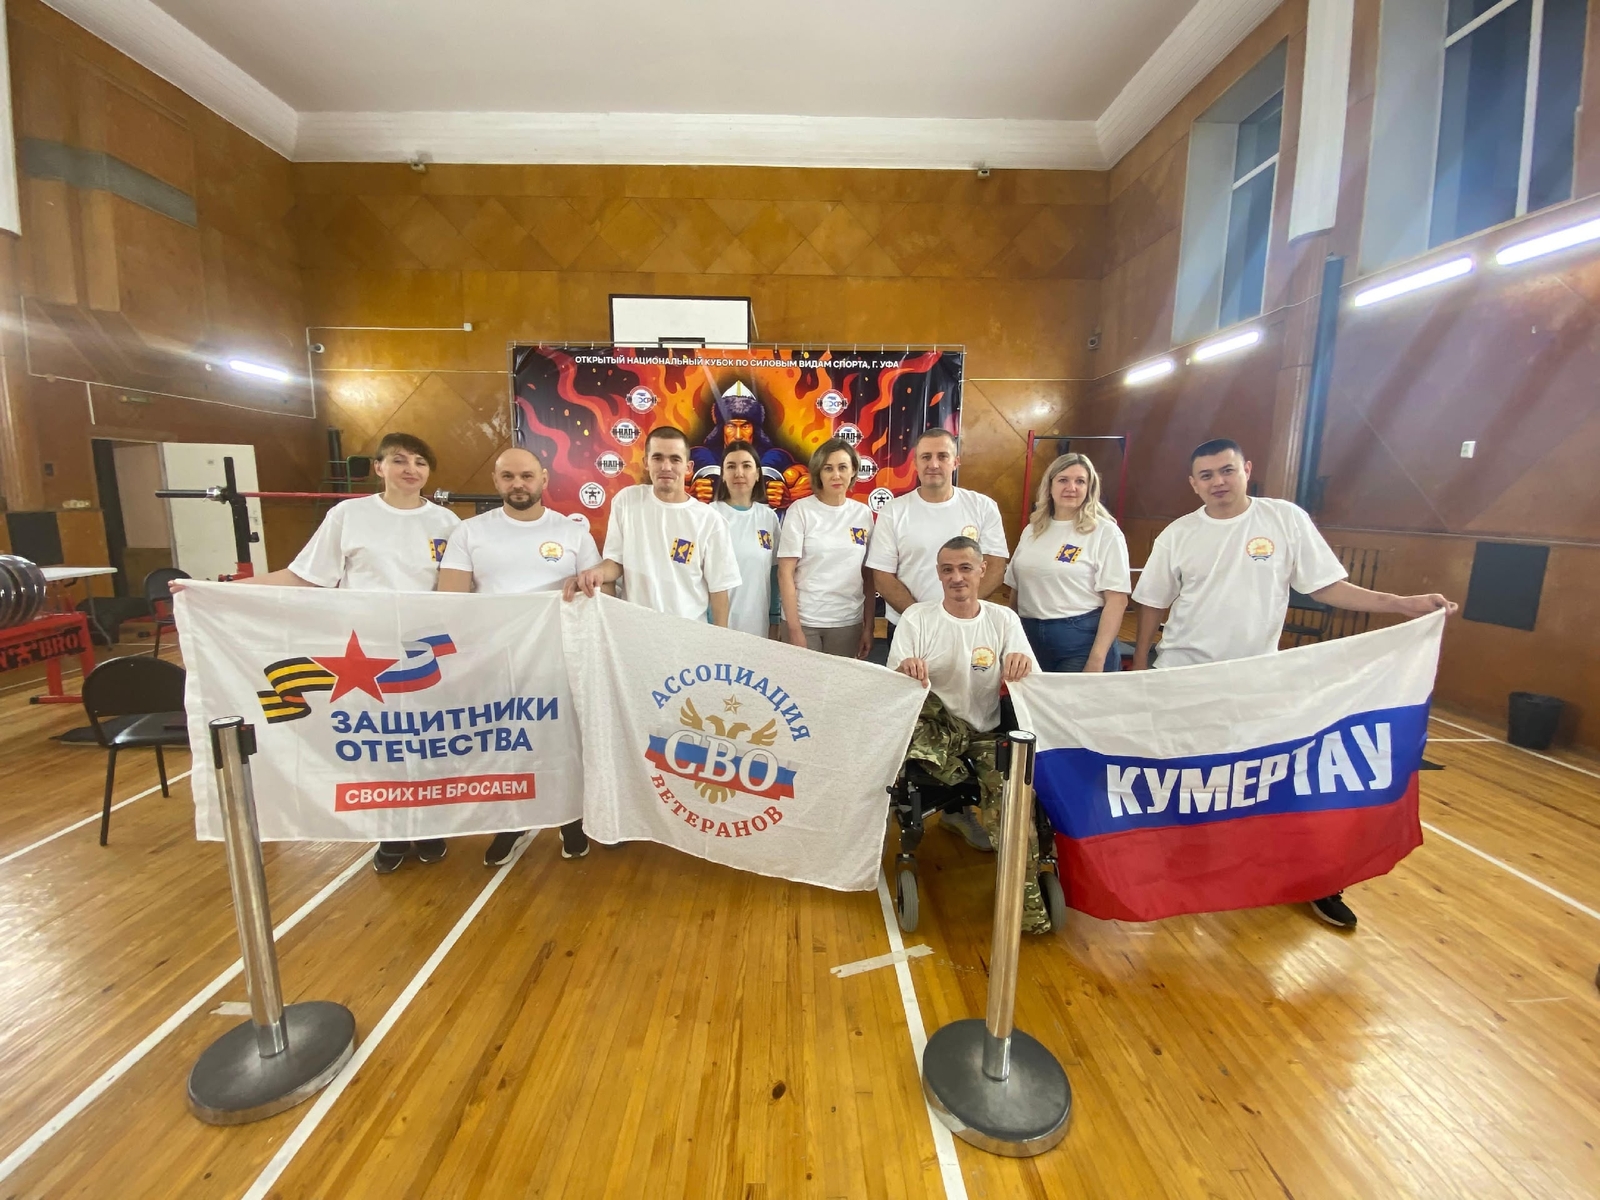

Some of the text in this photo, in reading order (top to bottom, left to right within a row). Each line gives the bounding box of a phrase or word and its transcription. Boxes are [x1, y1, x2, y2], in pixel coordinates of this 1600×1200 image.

[575, 355, 625, 364] ОТКРЫТЫЙ
[627, 355, 703, 365] НАЦИОНАЛЬНЫЙ
[750, 359, 798, 367] СИЛОВЫМ
[799, 360, 832, 368] ВИДАМ
[833, 360, 871, 369] СПОРТА,
[872, 360, 879, 368] Г.
[880, 360, 899, 368] УФА
[330, 697, 558, 736] ЗАЩИТНИКИ
[651, 663, 811, 742] АССОЦИАЦИЯ
[335, 727, 533, 762] ОТЕЧЕСТВА
[664, 729, 779, 792] СВО
[1106, 722, 1392, 818] КУМЕРТАУ
[344, 780, 528, 804] СВОИХ НЕ БРОСАЕМ
[651, 774, 783, 838] ВЕТЕРАНОВ
